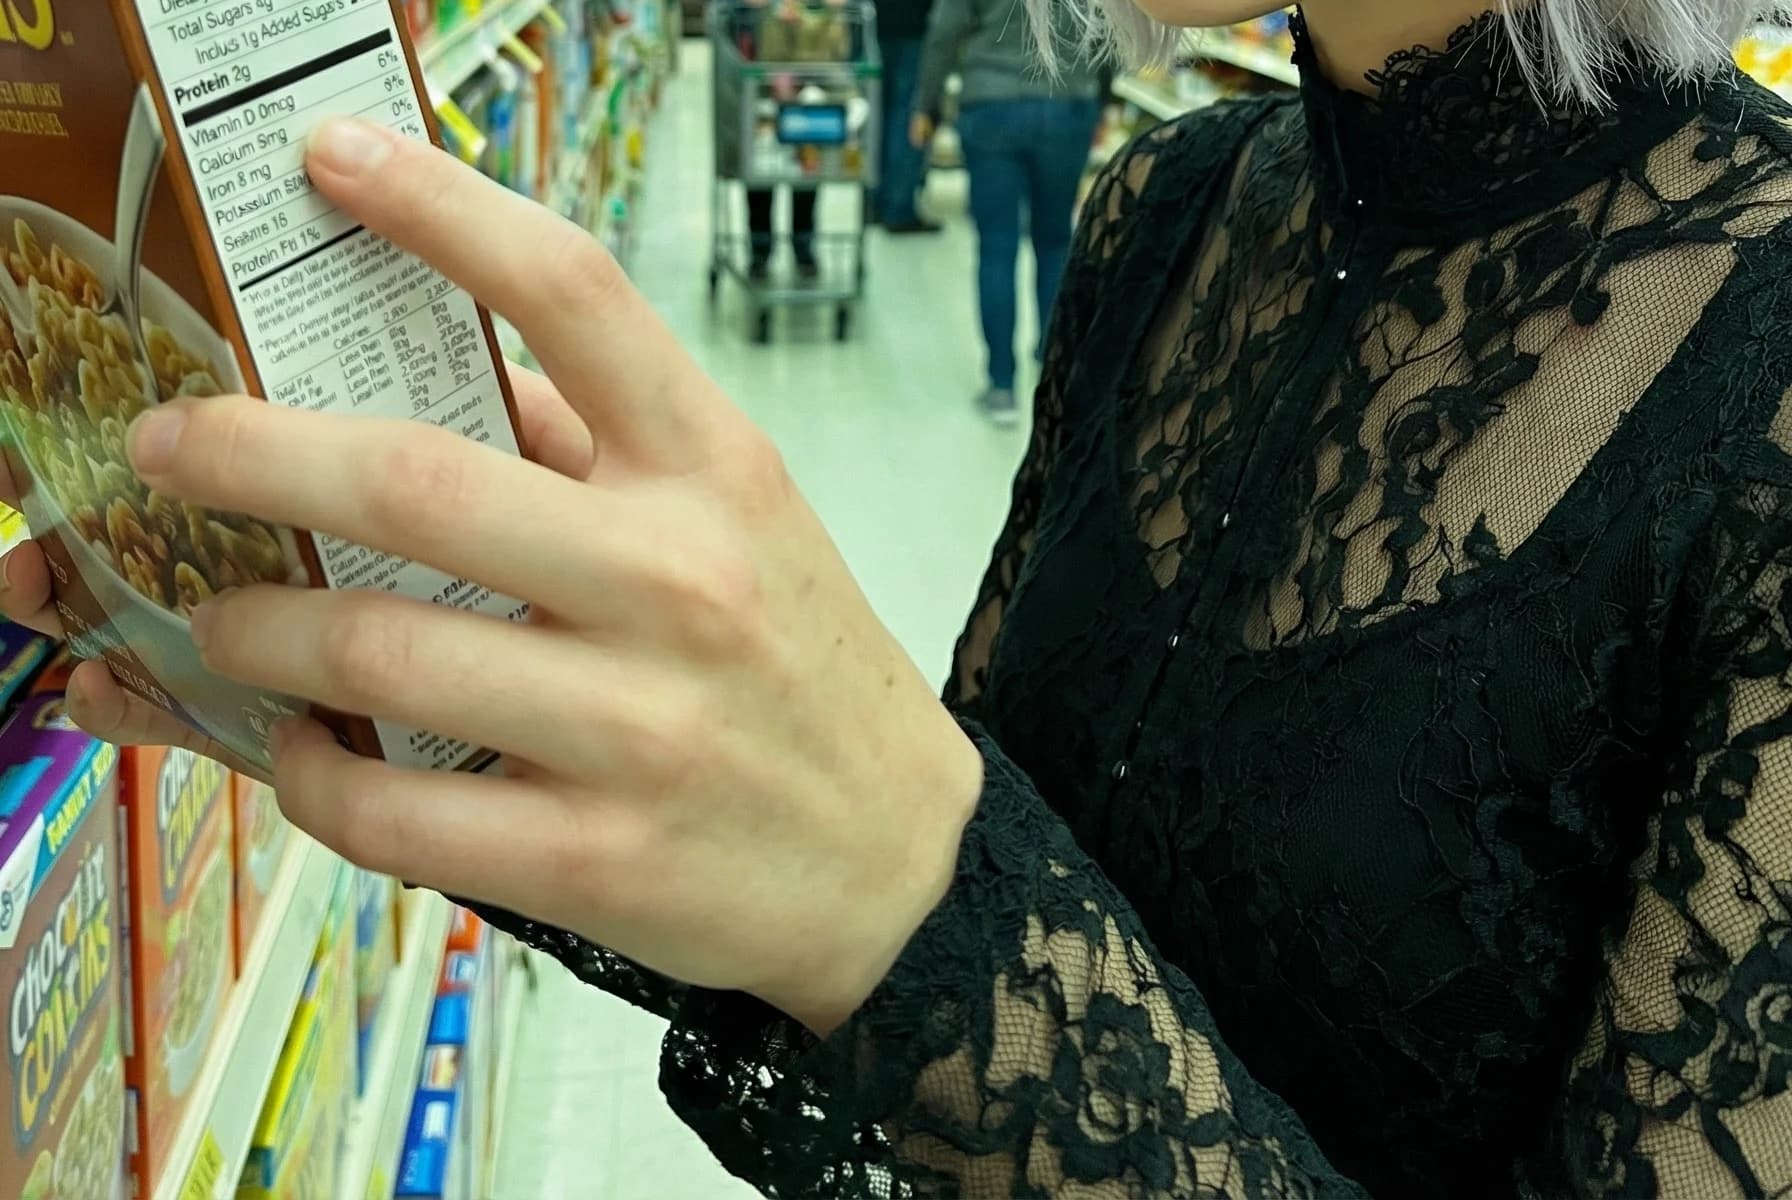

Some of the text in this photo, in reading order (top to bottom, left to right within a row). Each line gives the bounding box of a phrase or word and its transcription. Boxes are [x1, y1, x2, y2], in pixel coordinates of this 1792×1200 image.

[167, 17, 204, 43] Total
[206, 3, 253, 29] Sugars
[260, 14, 301, 41] Added
[174, 63, 251, 105] Protein 2g
[244, 110, 256, 126] D
[199, 141, 255, 175] Calcium
[207, 178, 236, 201] Iron
[250, 163, 271, 183] mg
[232, 249, 278, 279] Protein
